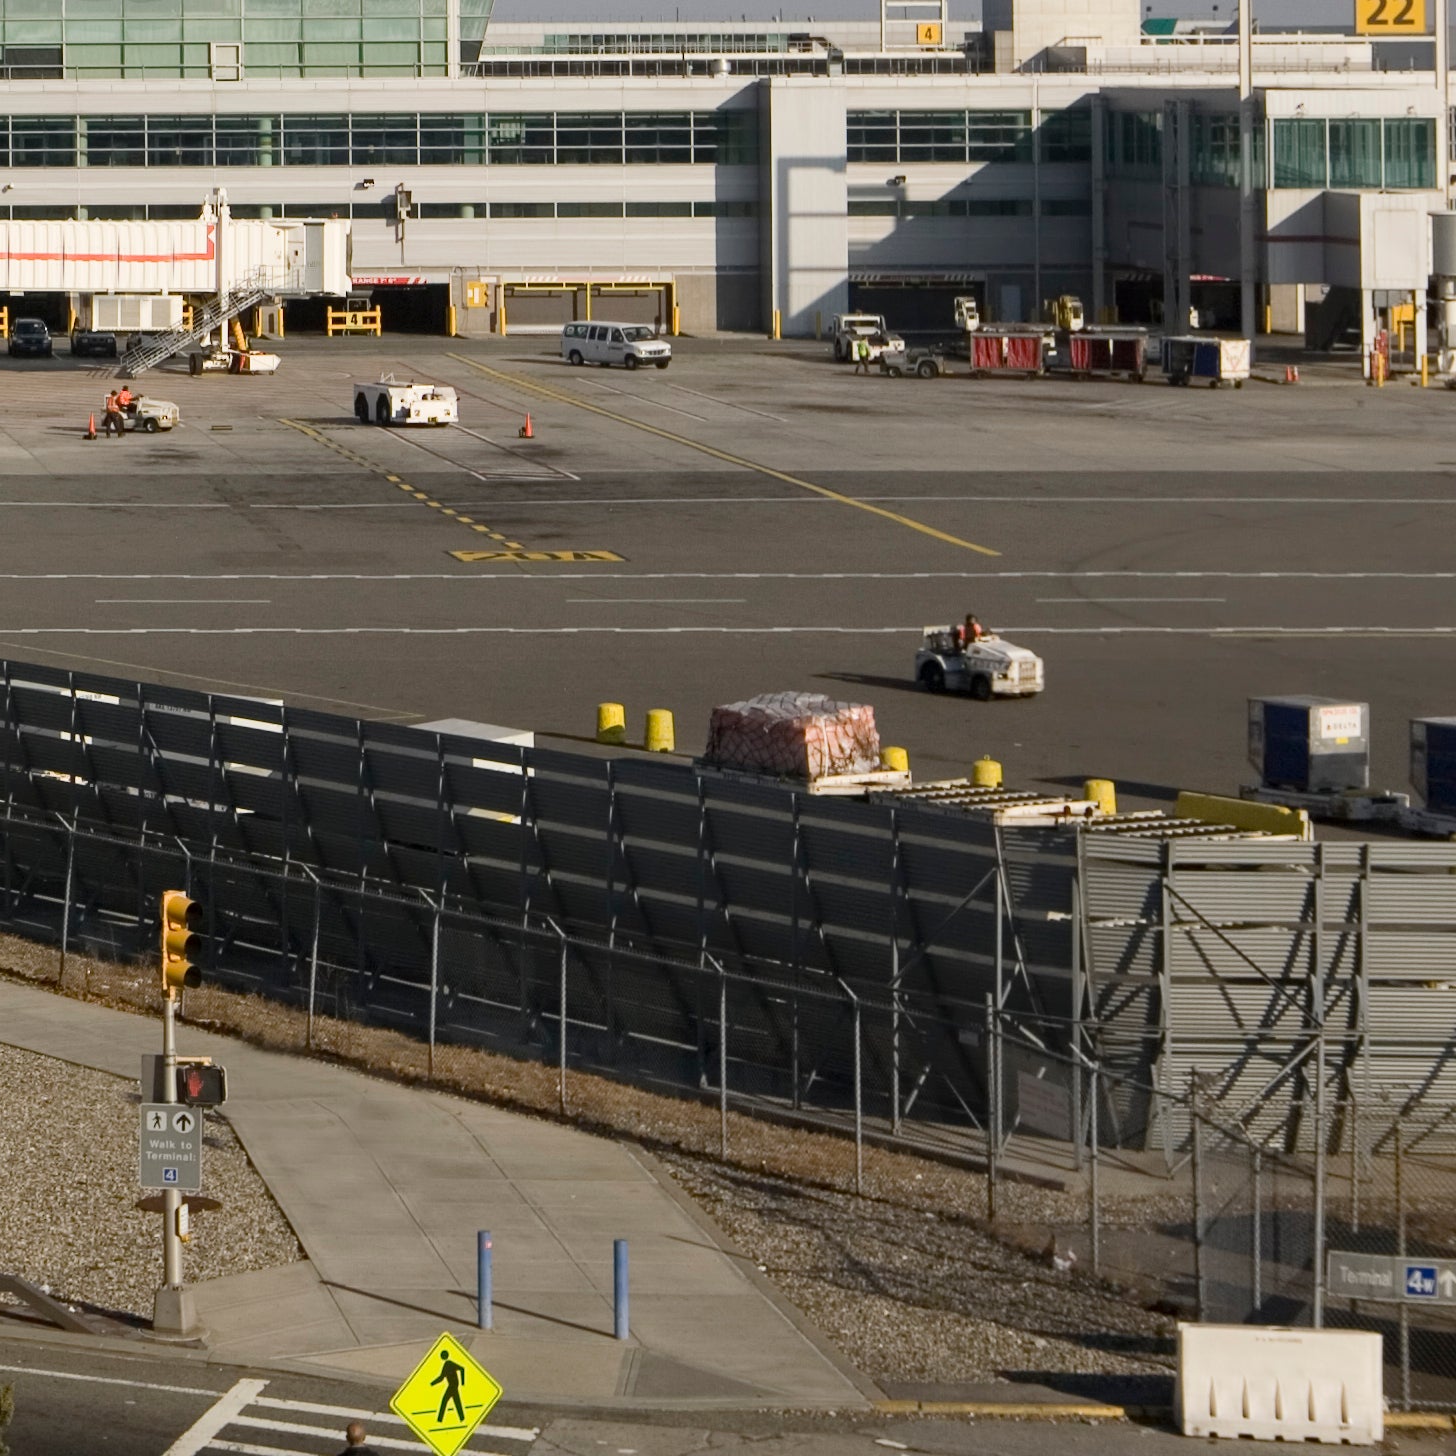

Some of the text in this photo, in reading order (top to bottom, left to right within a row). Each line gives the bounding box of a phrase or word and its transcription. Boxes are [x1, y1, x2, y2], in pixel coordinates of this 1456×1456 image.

[925, 27, 932, 40] 4
[350, 314, 358, 325] 4
[149, 1140, 175, 1148] Walk
[146, 1151, 196, 1161] Terminal:
[166, 1170, 174, 1180] 4
[1340, 1265, 1392, 1287] Terminal
